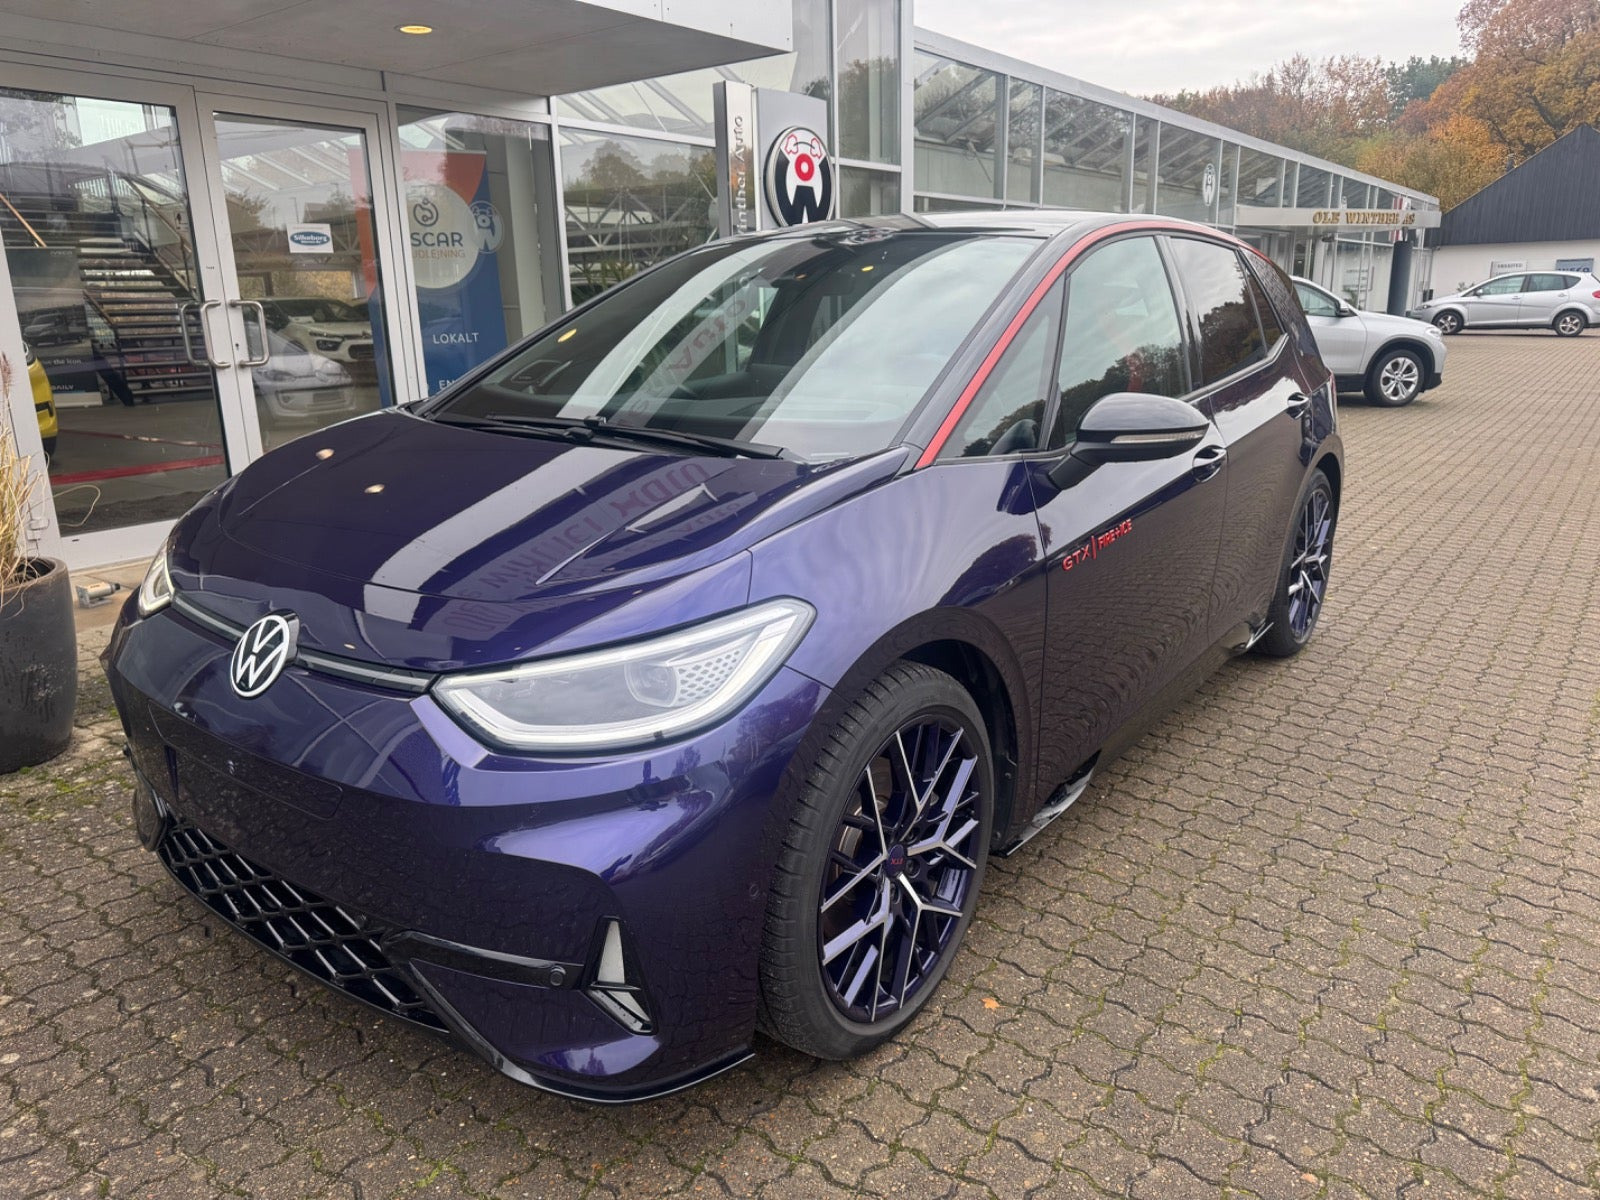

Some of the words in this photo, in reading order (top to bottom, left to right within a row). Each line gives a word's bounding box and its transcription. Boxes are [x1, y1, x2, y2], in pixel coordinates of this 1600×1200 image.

[734, 115, 746, 161] Auto
[735, 170, 747, 234] inther
[1312, 211, 1341, 225] OLE
[432, 332, 480, 345] LOKALT
[1062, 543, 1090, 572] GTX
